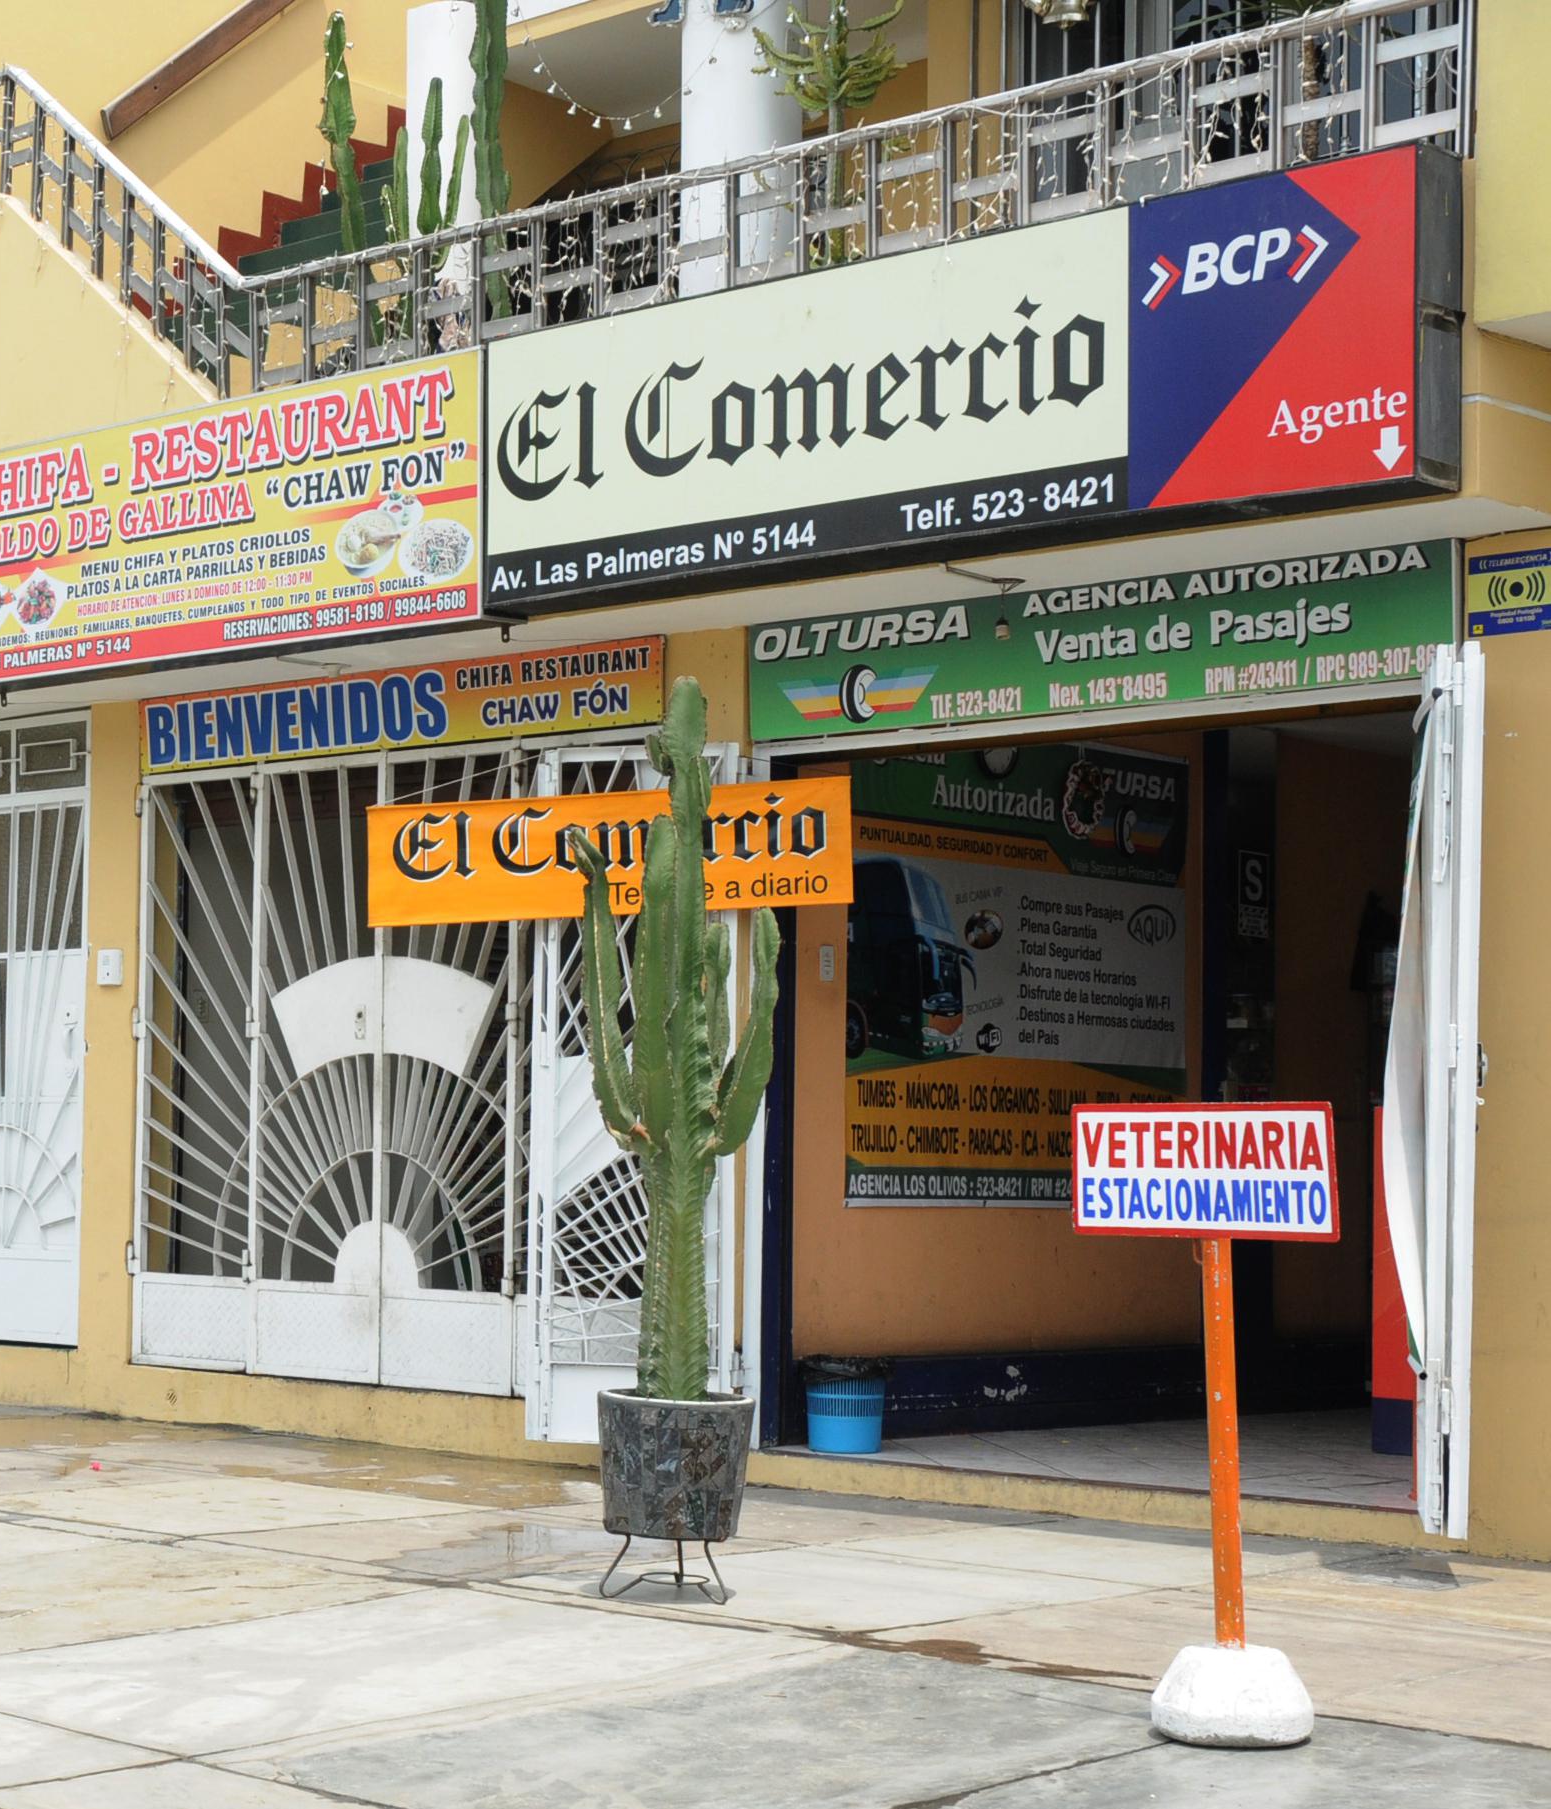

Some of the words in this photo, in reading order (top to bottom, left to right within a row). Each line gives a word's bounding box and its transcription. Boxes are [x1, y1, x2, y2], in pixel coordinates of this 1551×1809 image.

[1181, 227, 1291, 295] BCP
[497, 381, 604, 502] El
[625, 295, 1105, 478] Comercio
[1268, 386, 1407, 444] Agente
[131, 370, 451, 488] RESTAURANT
[68, 507, 109, 547] DE
[118, 481, 253, 539] GALLINA
[900, 499, 962, 532] Telf.
[67, 580, 109, 599] PLATOS
[114, 578, 121, 593] A
[125, 576, 139, 590] LA
[144, 570, 182, 587] CARTA
[186, 555, 253, 582] PARRILLAS
[258, 557, 265, 569] Y
[270, 545, 325, 567] BEBIDAS
[81, 559, 119, 578] MENU
[124, 556, 164, 572] CHIFA
[169, 551, 176, 565] Y
[182, 535, 234, 561] PLATOS
[239, 528, 310, 551] CRIOLLOS
[492, 565, 526, 592] Av.
[535, 558, 578, 586] Las
[586, 543, 704, 580] Palmeras
[752, 520, 816, 556] 5144
[1023, 578, 1175, 617] AGENCIA
[1184, 545, 1427, 600] AUTORIZADA
[224, 615, 313, 640] RESERVACIONES:
[316, 602, 384, 628] 99581-8198
[395, 590, 466, 617] 99844-6608
[754, 606, 970, 661] OLTURSA
[1035, 622, 1137, 664] Venta
[1146, 614, 1192, 653] de
[1210, 597, 1350, 647] Pasajes
[3, 645, 72, 669] PALMERAS
[96, 636, 131, 654] 5144
[456, 662, 513, 690] CHIFA
[521, 647, 650, 682] RESTAURANT
[1205, 666, 1236, 694] RPM
[1238, 660, 1297, 691] #243411
[1316, 655, 1345, 683] RPC
[147, 671, 446, 766] BIENVENIDOS
[481, 694, 559, 725] CHAW
[574, 681, 628, 716] FÓN
[957, 686, 1022, 718] 523-8421
[1050, 682, 1084, 708] Nex.
[931, 774, 1054, 821] Autorizada
[392, 811, 477, 882] El
[860, 826, 932, 848] PUNTUALIDAD,
[936, 835, 993, 857] SEGURIDAD
[995, 843, 1001, 855] Y
[1004, 843, 1048, 862] CONFORT
[725, 881, 741, 899] a
[750, 870, 828, 897] diario
[1065, 903, 1083, 916] sus
[1085, 903, 1124, 923] Pasajes
[1049, 942, 1102, 962] Seguridad
[1055, 968, 1091, 982] nuevos
[1093, 968, 1137, 986] Horarios
[1082, 1121, 1323, 1170] VETERINARIA
[849, 1174, 900, 1195] AGENCIA
[904, 1175, 925, 1195] LOS
[928, 1175, 967, 1196] OLIVOS
[977, 1178, 1022, 1197] 523-8421
[1031, 1178, 1052, 1197] RPM
[1082, 1178, 1327, 1225] ESTACIONAMIENTO
